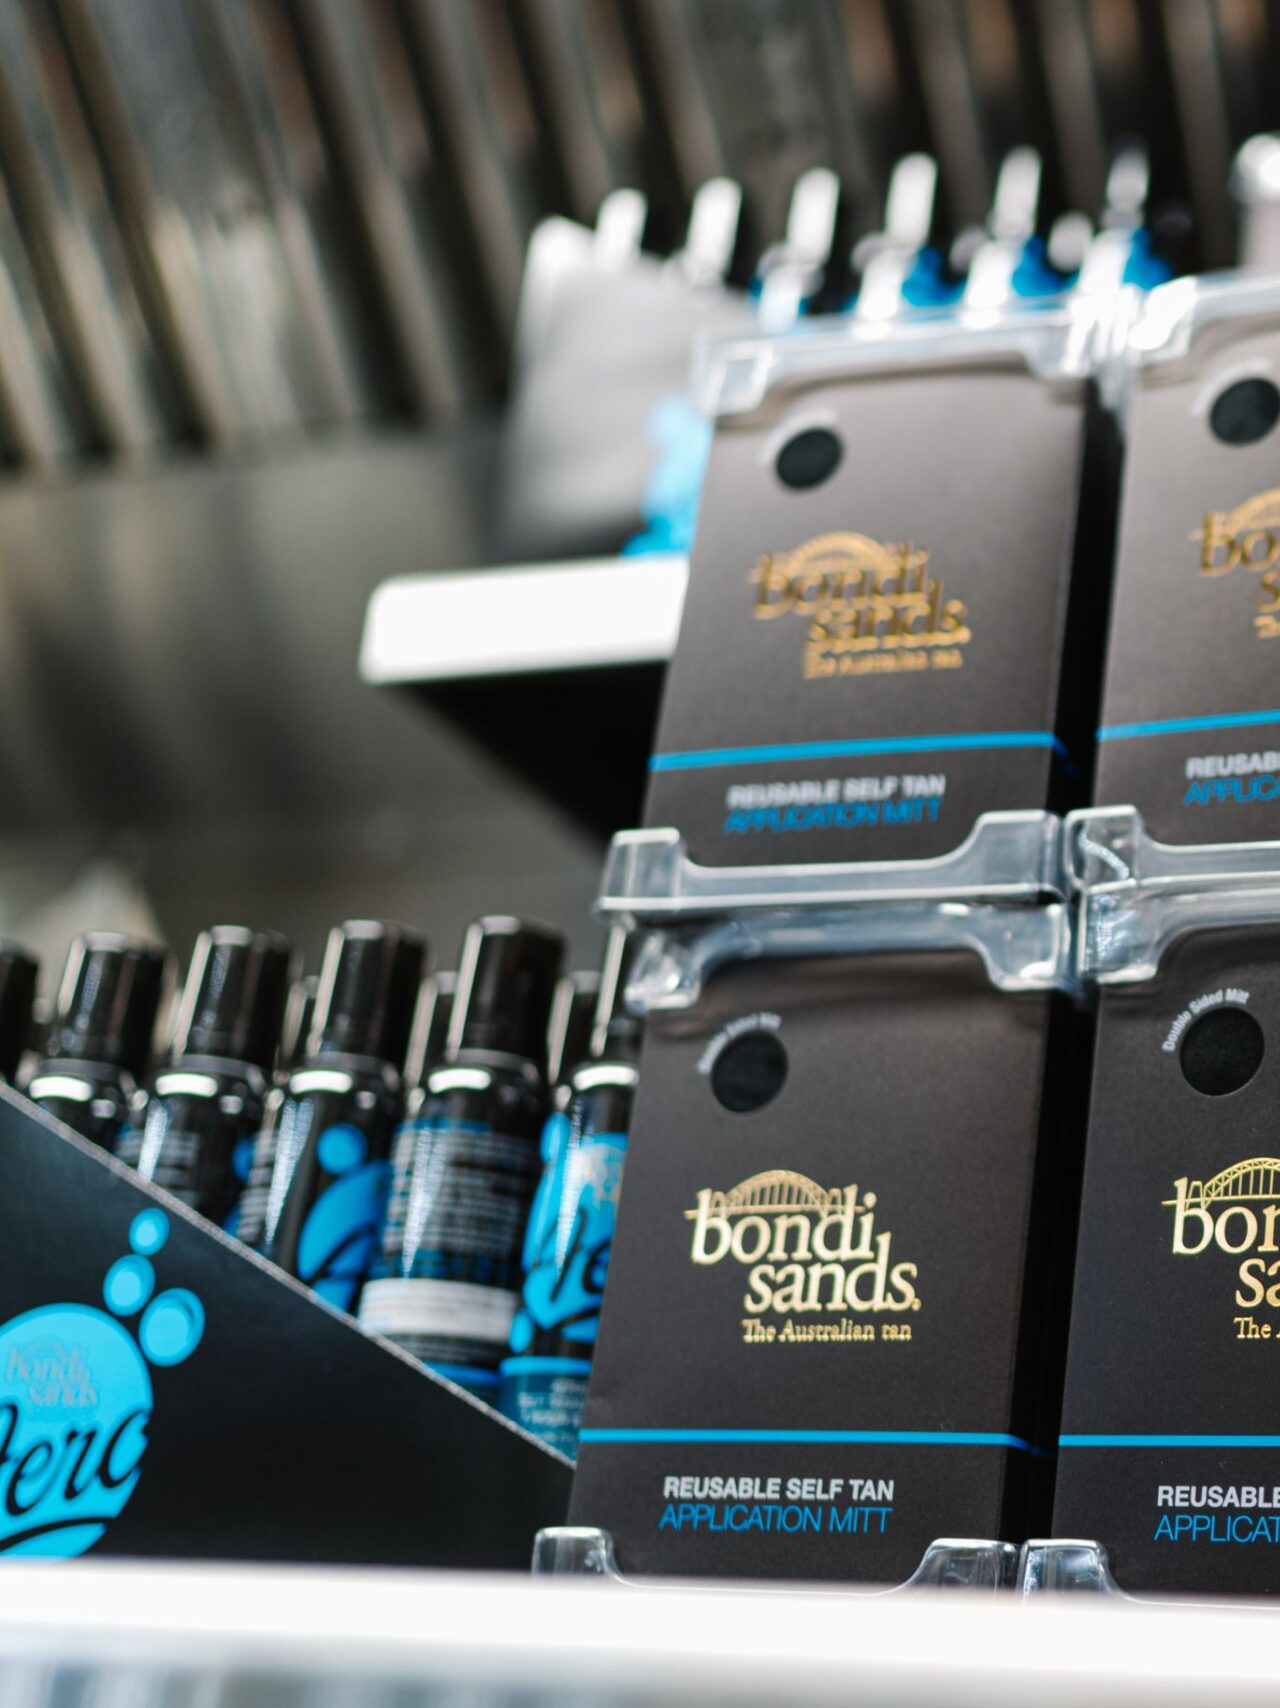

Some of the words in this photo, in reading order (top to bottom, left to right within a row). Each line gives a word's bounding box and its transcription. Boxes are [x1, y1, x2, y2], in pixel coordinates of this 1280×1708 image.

[691, 1183, 877, 1265] bondi
[743, 1231, 919, 1314] sands
[1233, 1315, 1272, 1339] The
[663, 1475, 781, 1499] REUSABLE
[785, 1477, 844, 1501] SELF
[849, 1478, 895, 1502] TAN
[658, 1502, 823, 1533] APPLICATION
[828, 1505, 894, 1535] MITT
